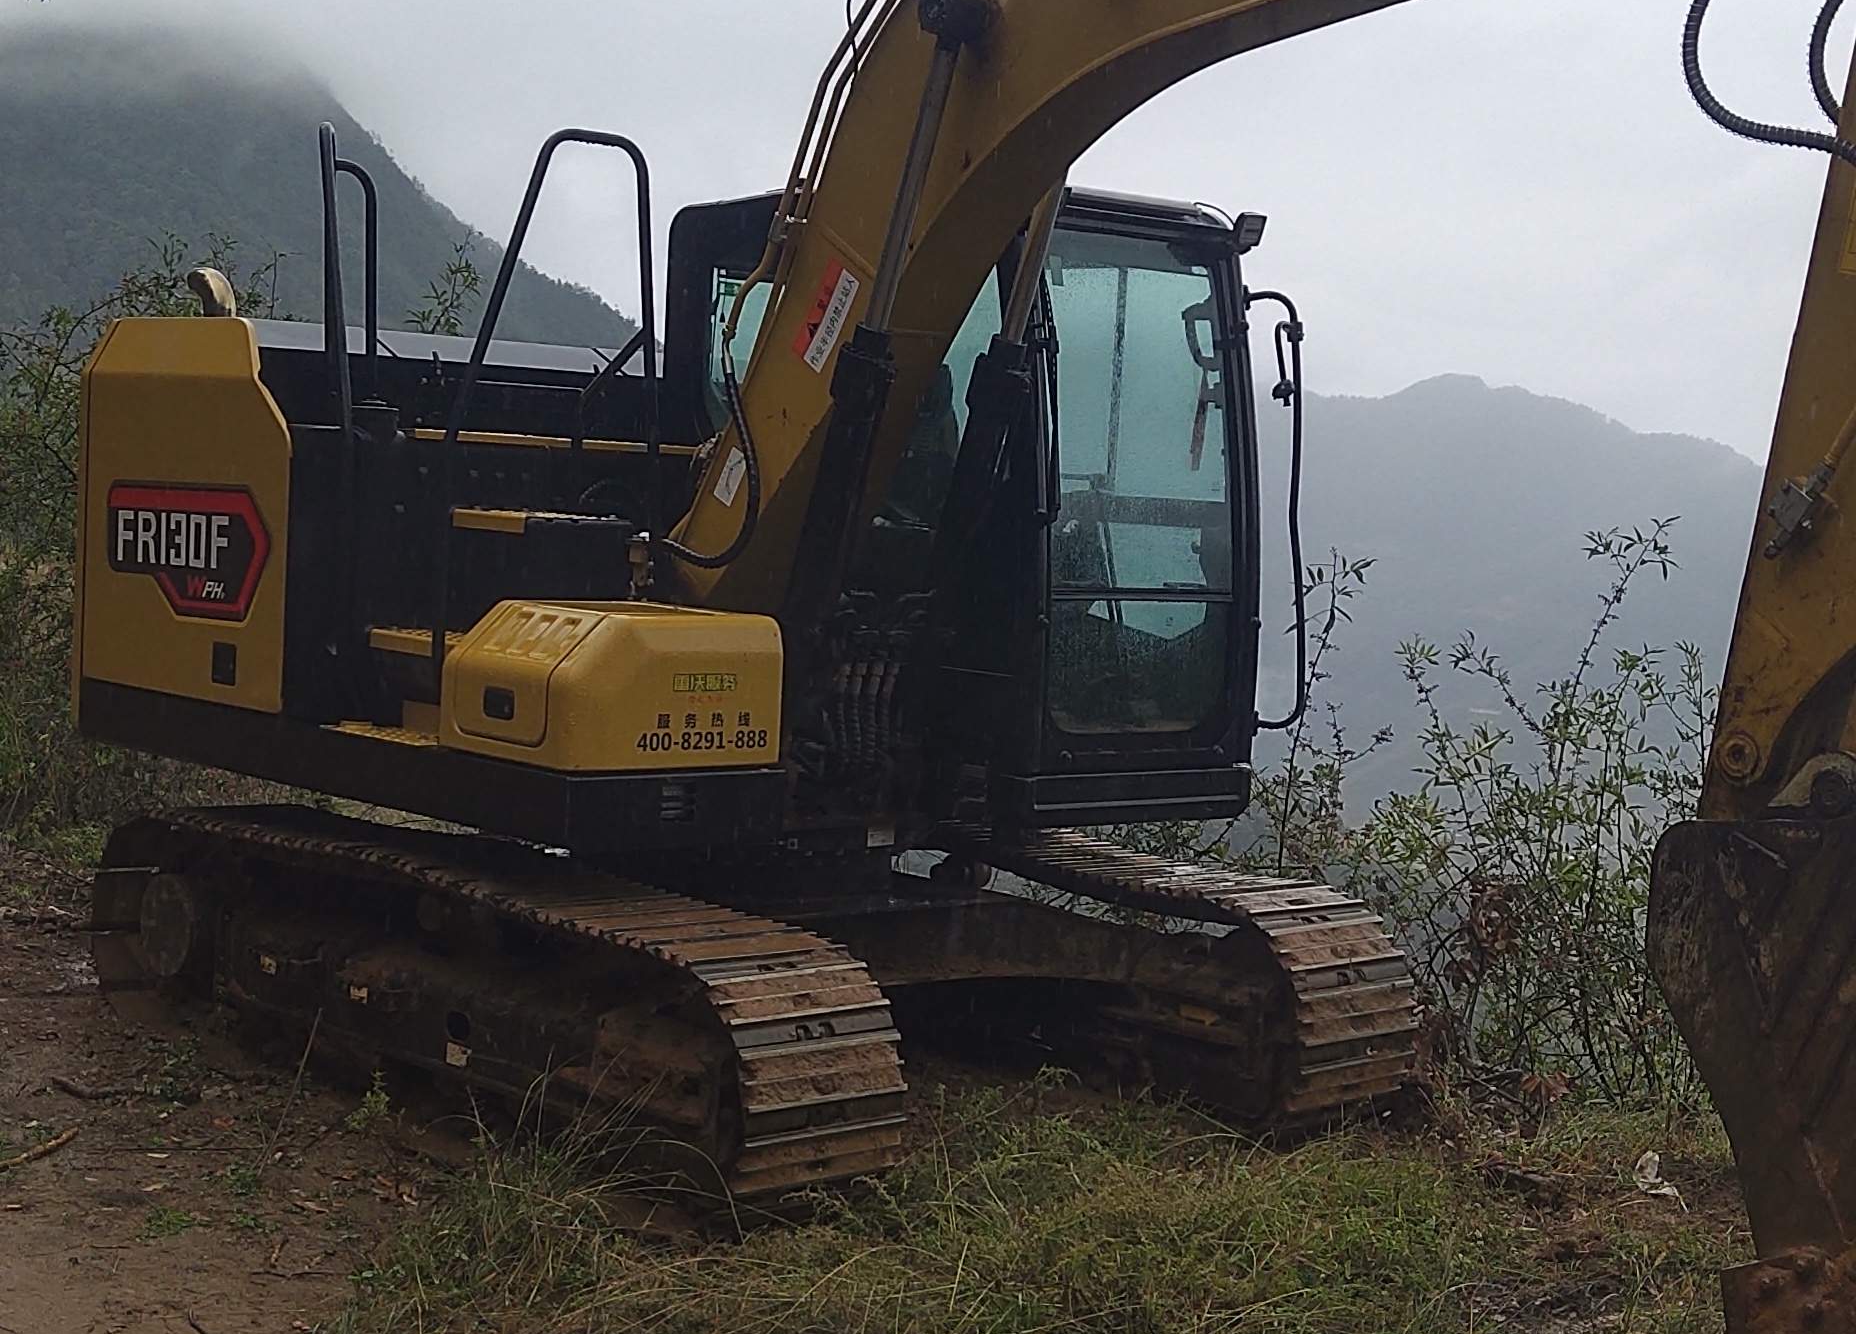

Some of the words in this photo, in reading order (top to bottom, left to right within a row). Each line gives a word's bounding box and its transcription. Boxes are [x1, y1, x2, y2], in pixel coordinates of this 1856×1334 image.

[116, 509, 230, 569] FR130F
[657, 711, 751, 729] 服务热线
[636, 730, 768, 752] 400-8291-888
